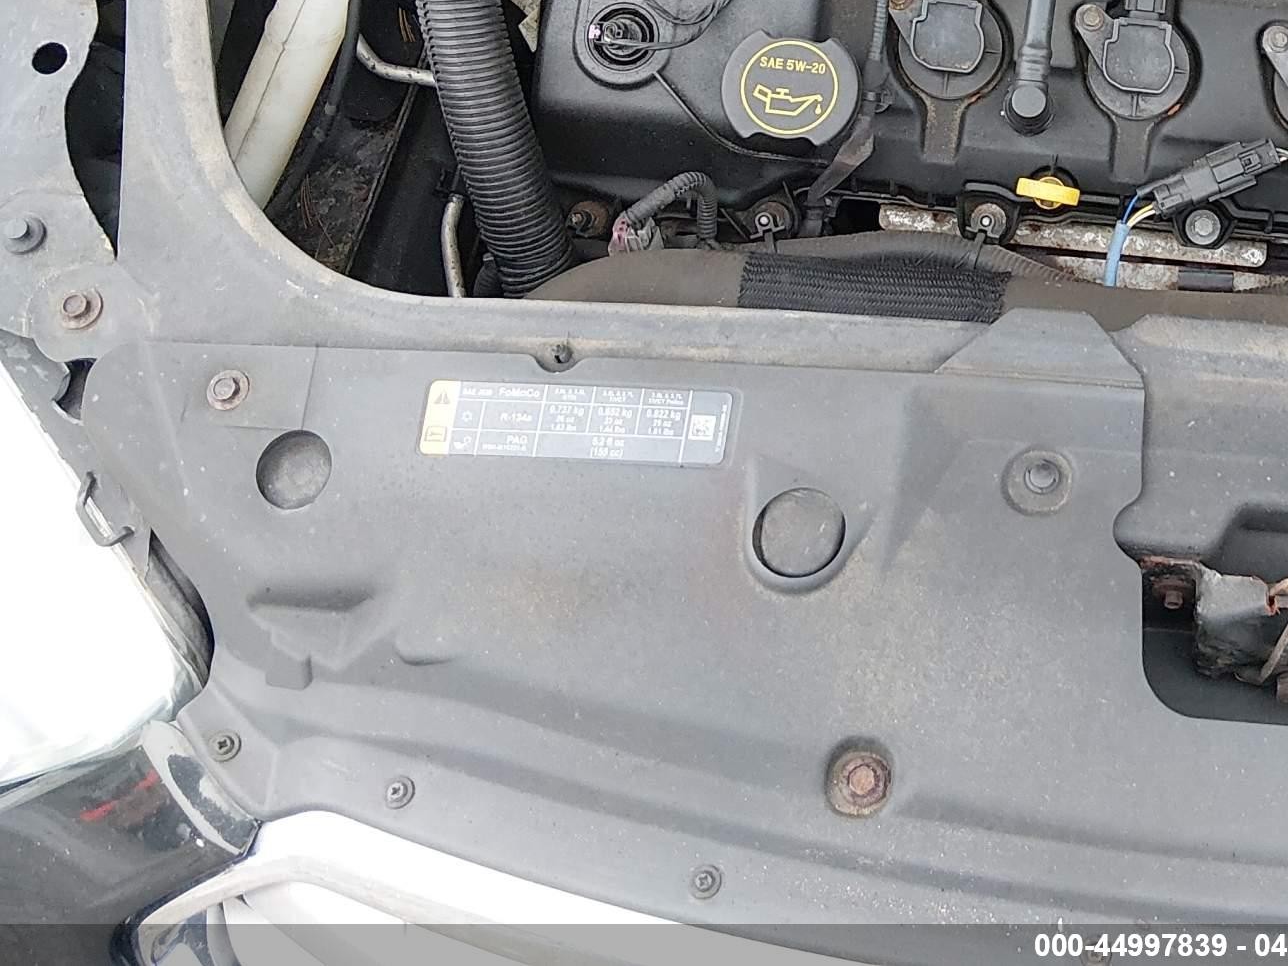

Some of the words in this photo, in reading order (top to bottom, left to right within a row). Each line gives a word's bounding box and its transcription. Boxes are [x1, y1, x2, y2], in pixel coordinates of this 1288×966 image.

[760, 56, 783, 69] SAE
[786, 59, 826, 74] 5W-20
[498, 386, 540, 398] FoMoCo
[499, 412, 532, 423] R-134a
[572, 407, 585, 418] kg
[622, 408, 633, 419] kg
[669, 411, 681, 421] kg
[506, 434, 528, 445] PAG
